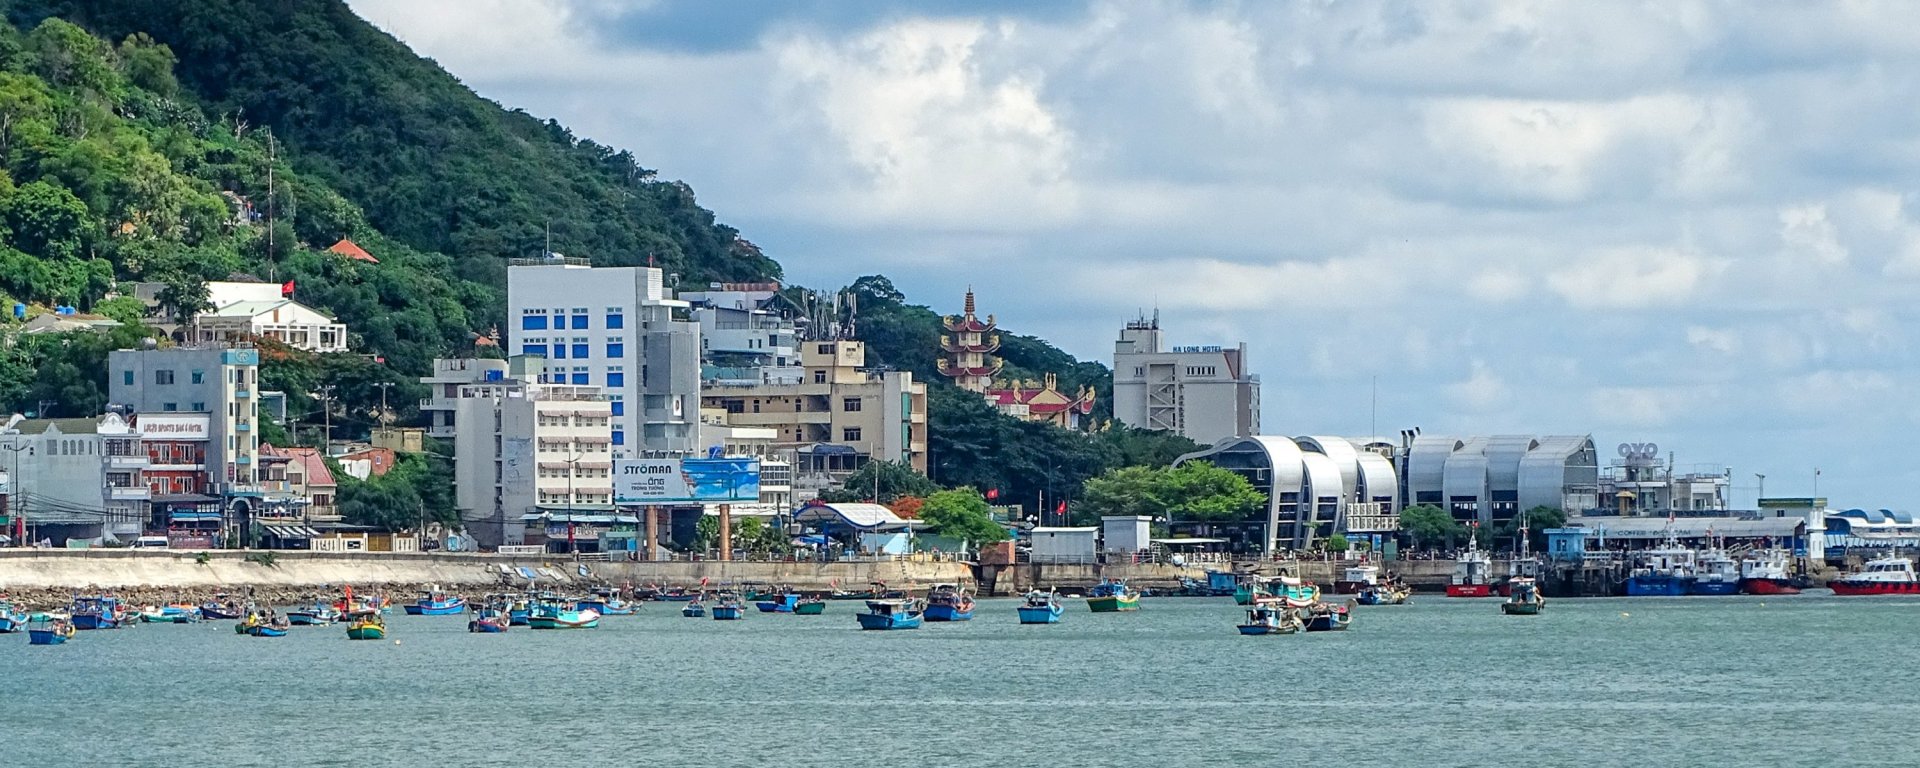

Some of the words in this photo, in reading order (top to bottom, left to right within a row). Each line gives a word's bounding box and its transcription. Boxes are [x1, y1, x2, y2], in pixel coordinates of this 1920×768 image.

[1202, 345, 1222, 353] HOTEL
[188, 424, 203, 432] HOTEL
[1617, 442, 1659, 459] OYO
